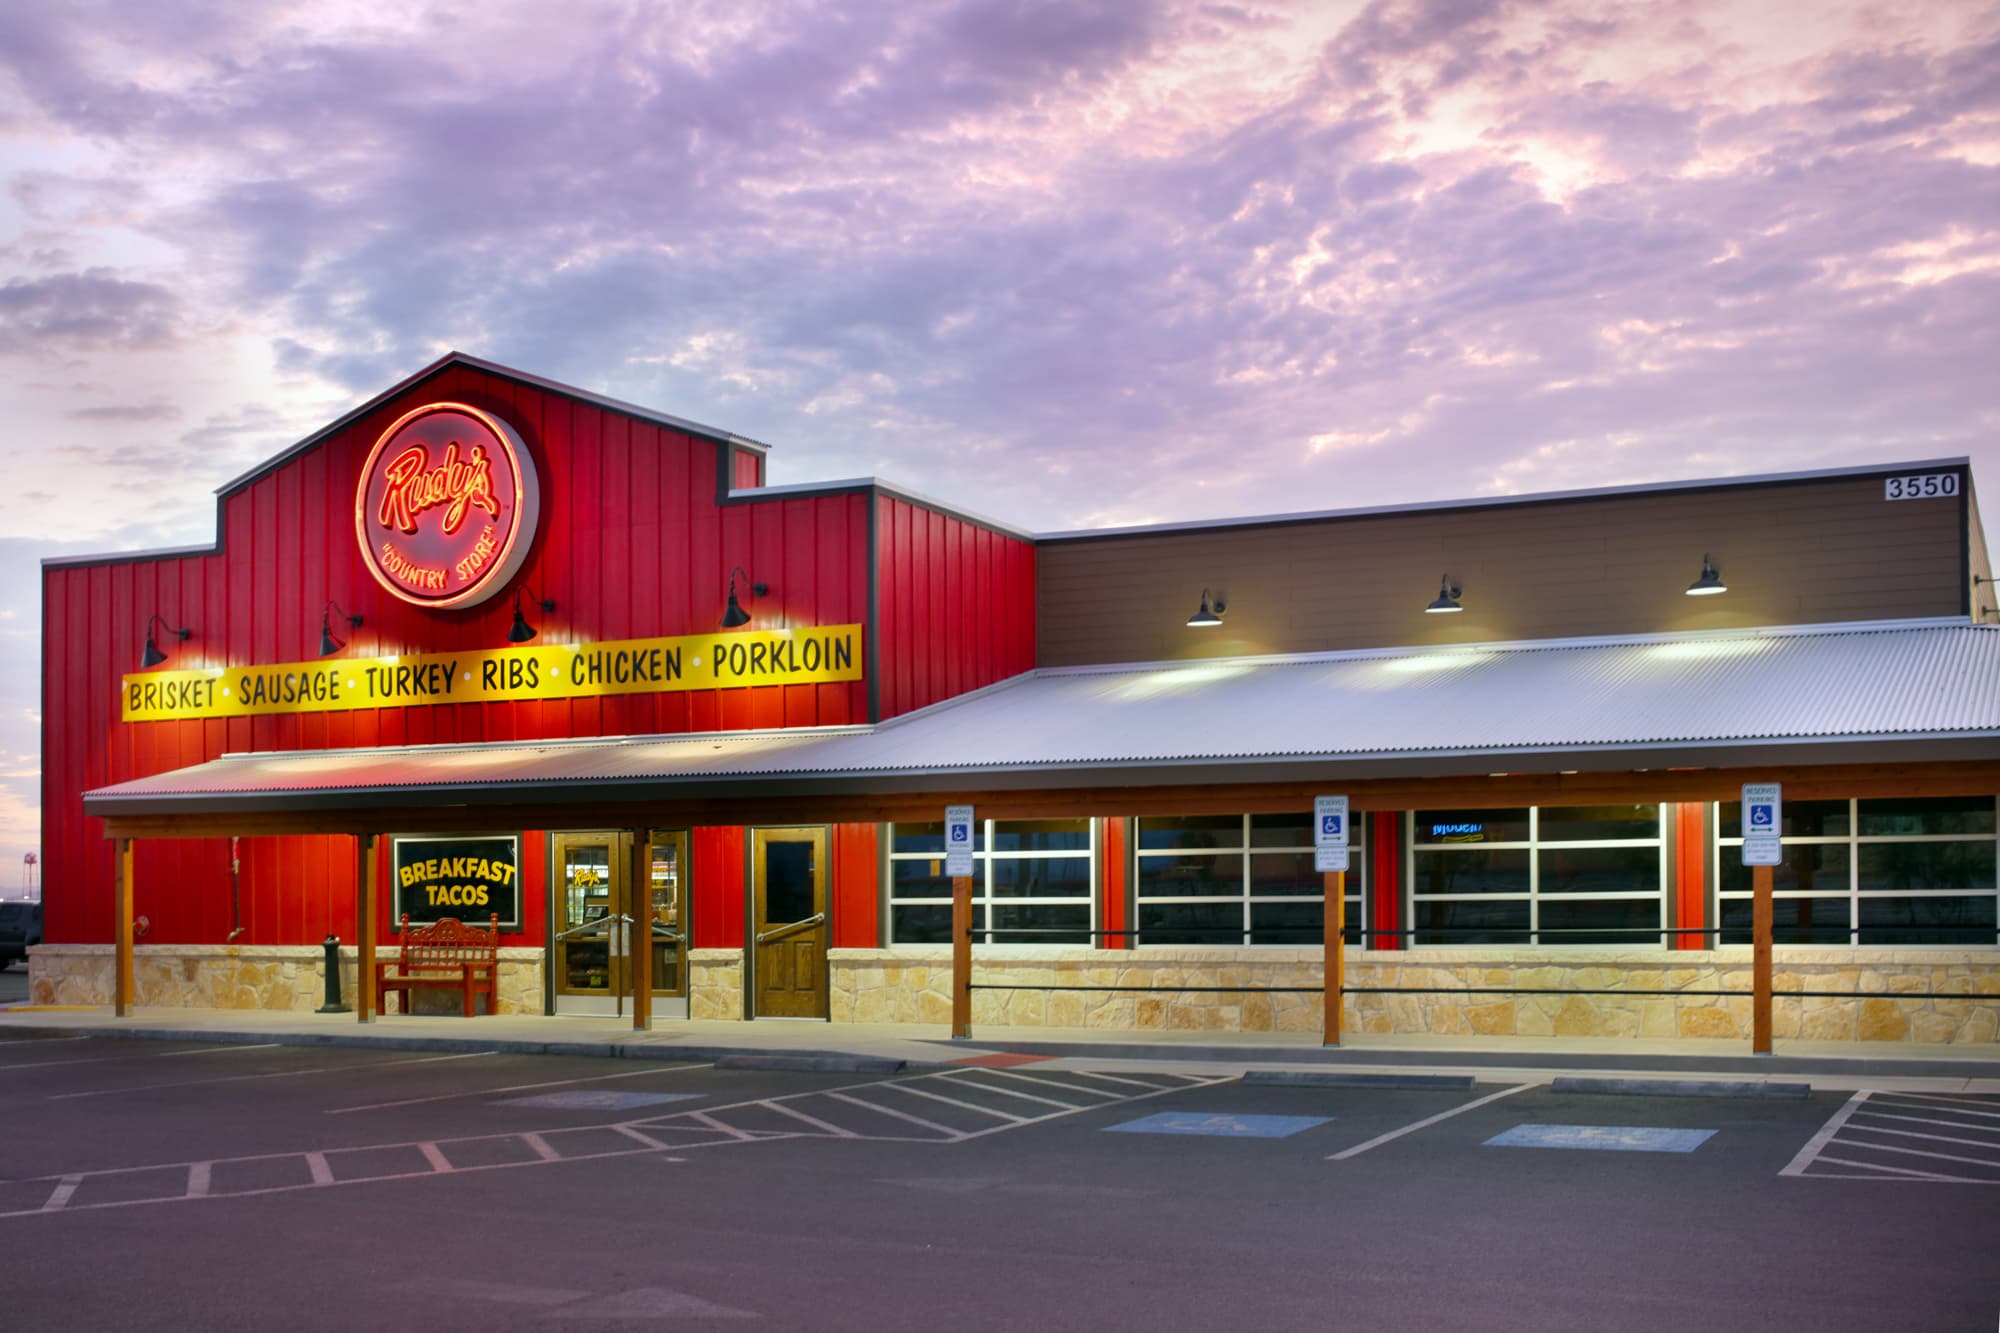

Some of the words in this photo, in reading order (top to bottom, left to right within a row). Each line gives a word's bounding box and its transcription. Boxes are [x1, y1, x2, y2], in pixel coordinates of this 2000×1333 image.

[378, 443, 498, 532] Rudy's
[1889, 475, 1955, 498] 3550
[129, 677, 217, 711] BRISKET
[238, 670, 340, 706] SAUSAGE
[365, 660, 457, 698] TURKEY
[482, 657, 540, 691] RIBS
[571, 646, 682, 687] CHICKEN
[713, 634, 852, 679] PORKLOIN
[400, 857, 515, 888] BREAKFAST
[425, 885, 489, 906] TACOS
